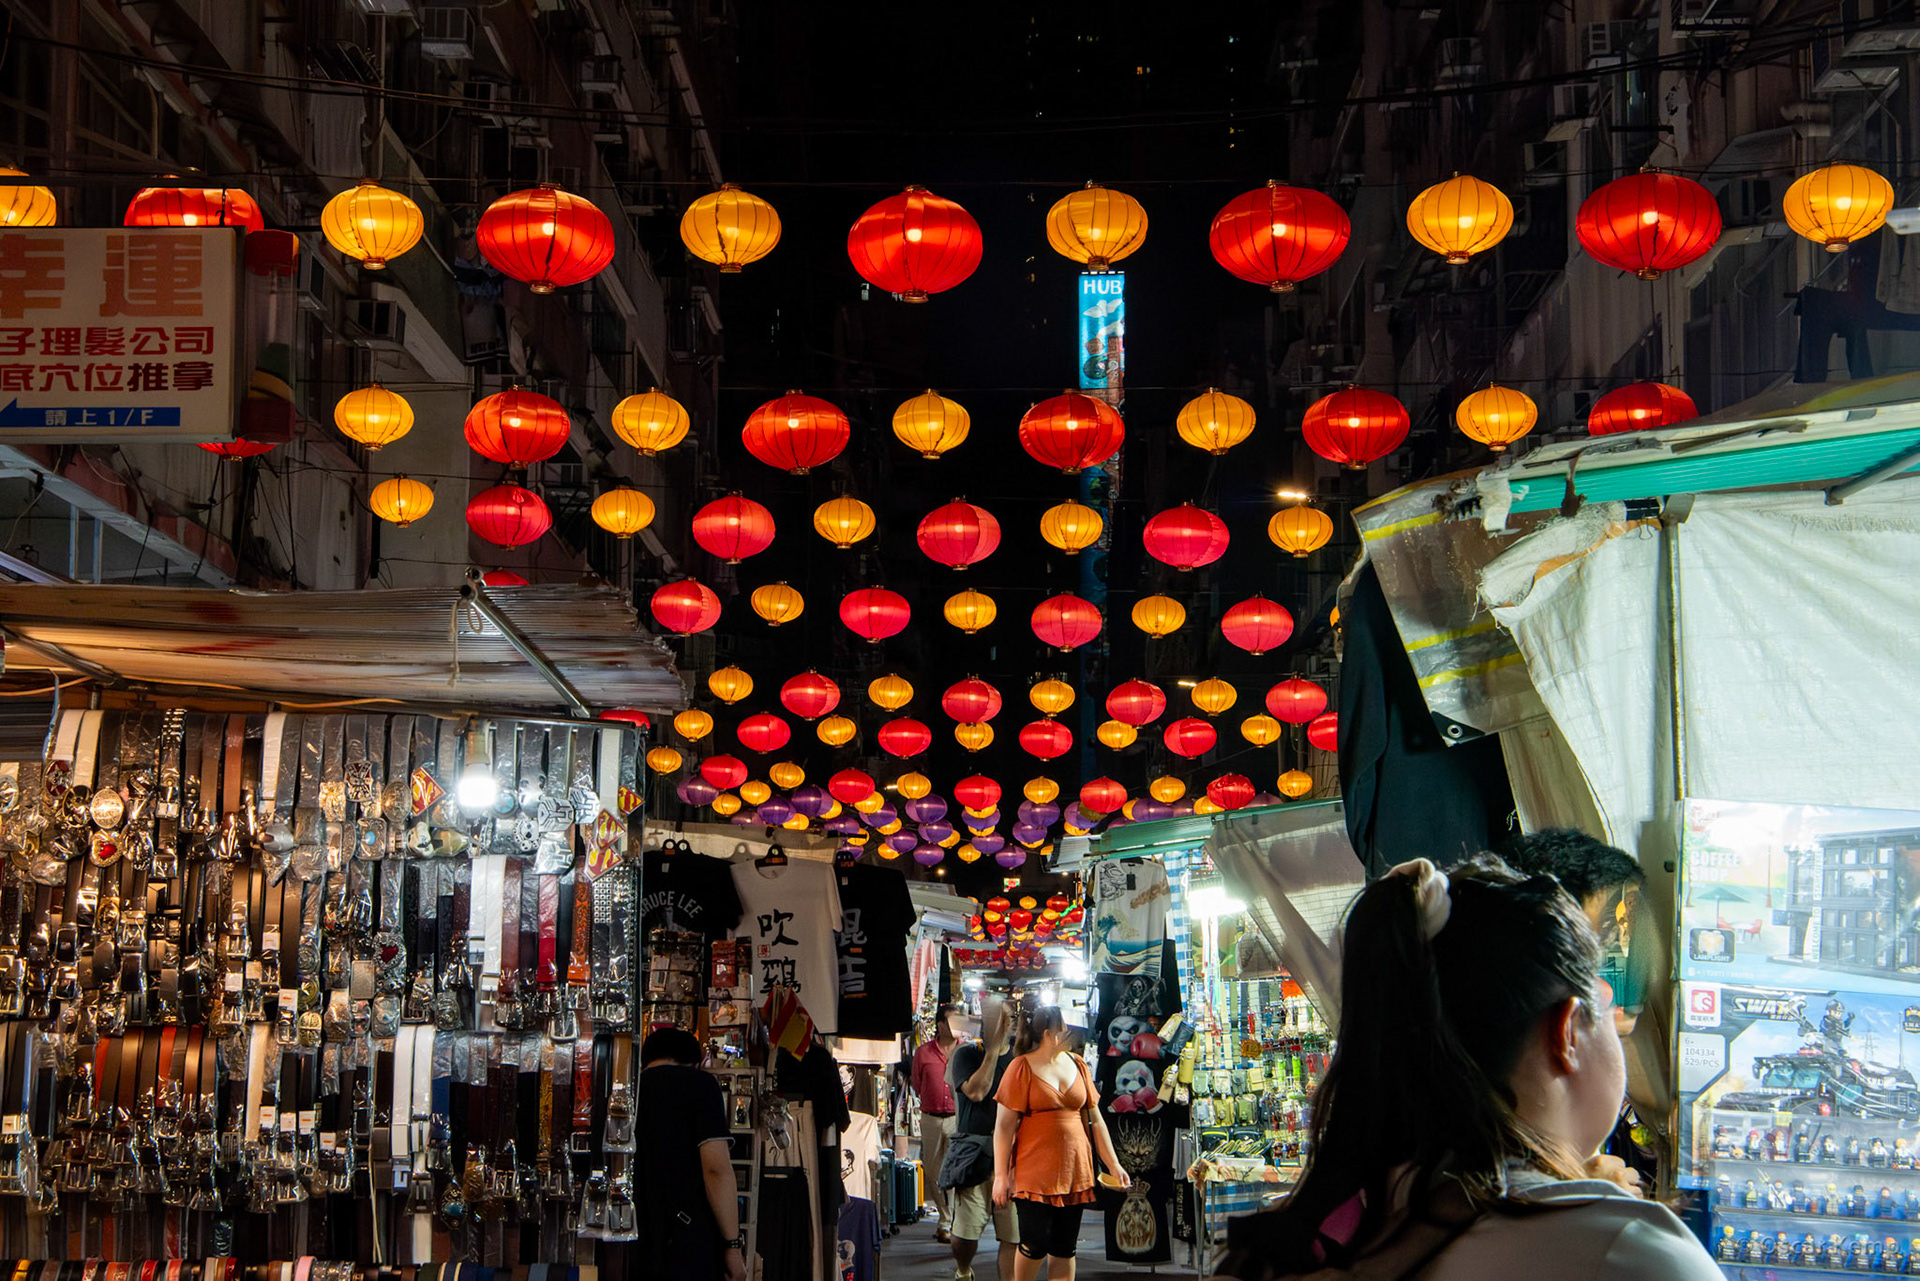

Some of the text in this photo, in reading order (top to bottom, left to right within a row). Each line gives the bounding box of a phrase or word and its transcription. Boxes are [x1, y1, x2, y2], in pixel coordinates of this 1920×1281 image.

[1083, 279, 1122, 294] HUB
[1691, 851, 1741, 868] COFFEE
[1691, 867, 1728, 882] SHOP
[677, 893, 703, 919] LEE
[1693, 953, 1731, 962] LAMPLIGHT
